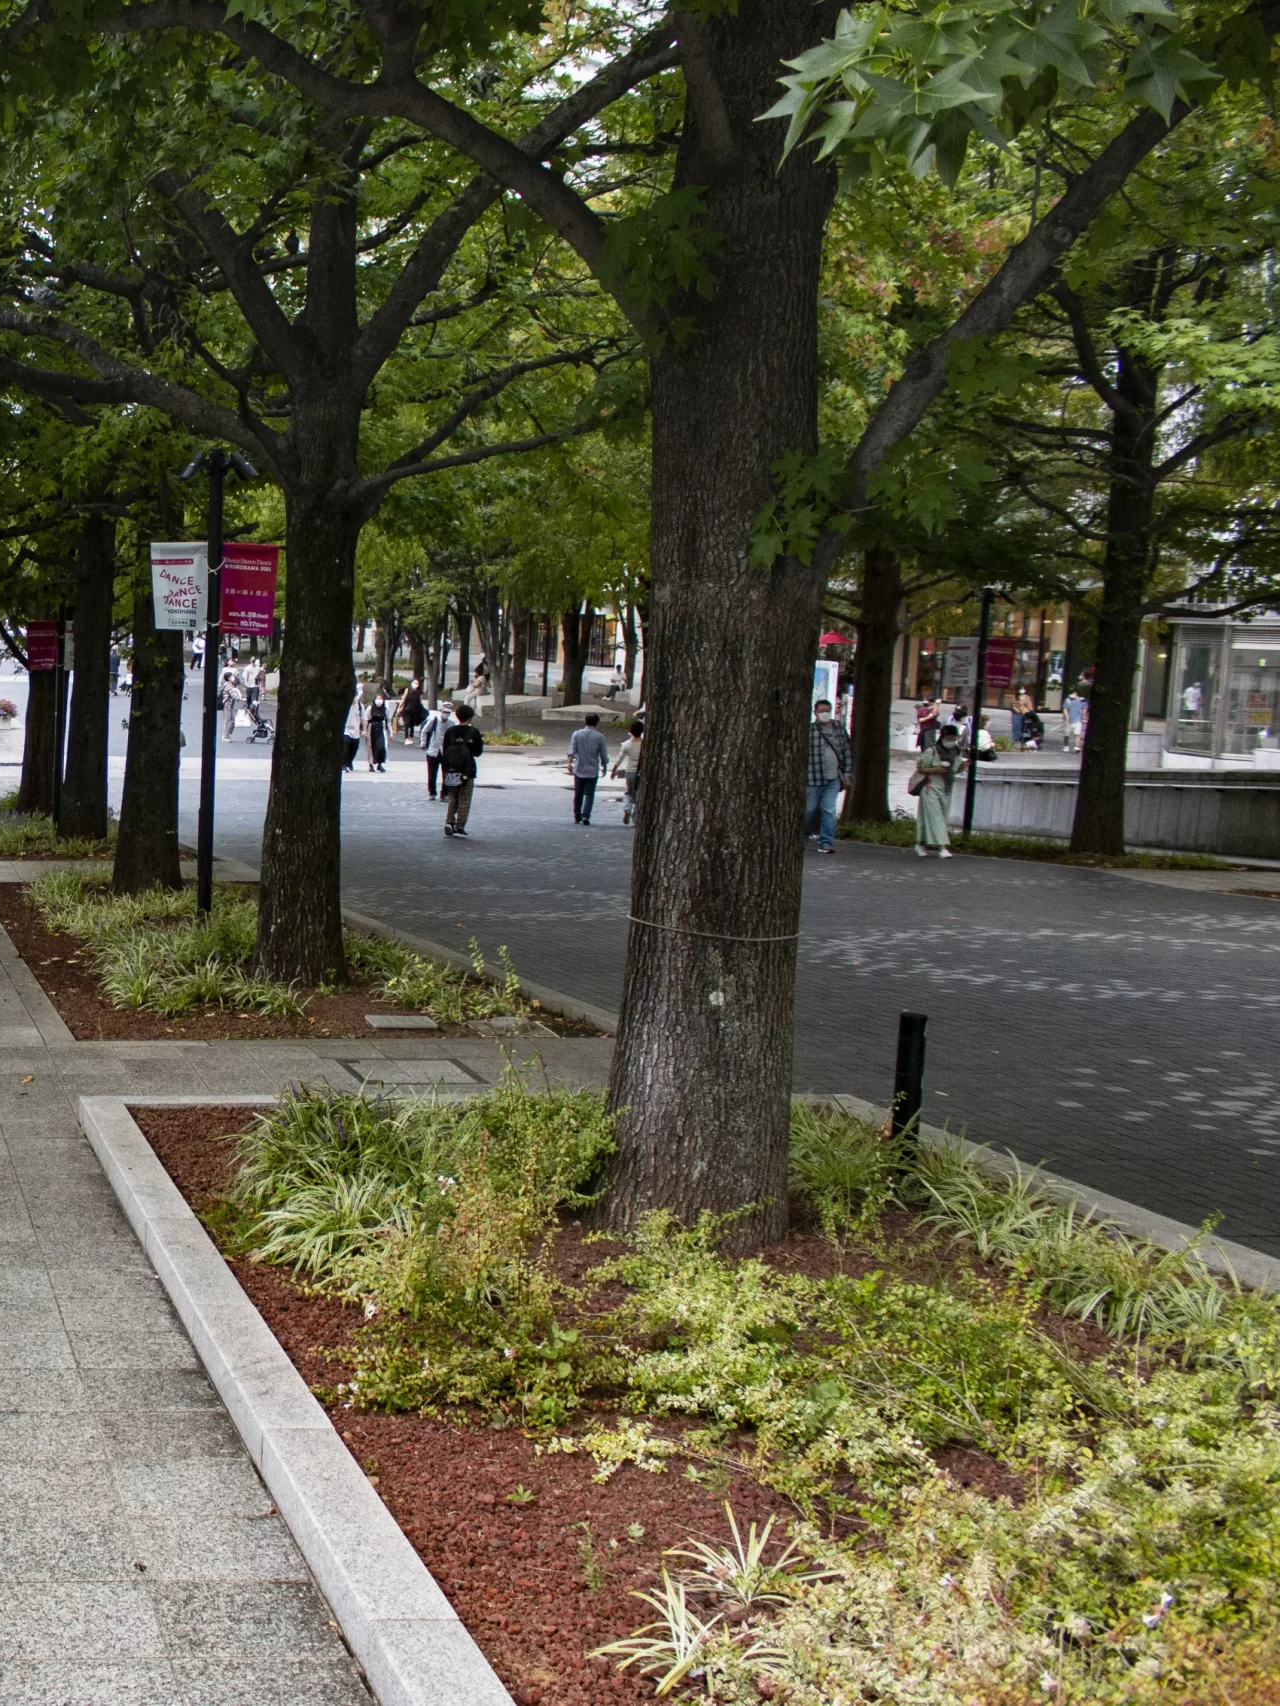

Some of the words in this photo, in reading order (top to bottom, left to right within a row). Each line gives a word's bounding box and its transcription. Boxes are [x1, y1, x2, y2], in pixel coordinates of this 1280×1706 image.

[160, 569, 193, 585] DANCE
[168, 585, 202, 598] DANCE
[163, 595, 197, 609] DANCE
